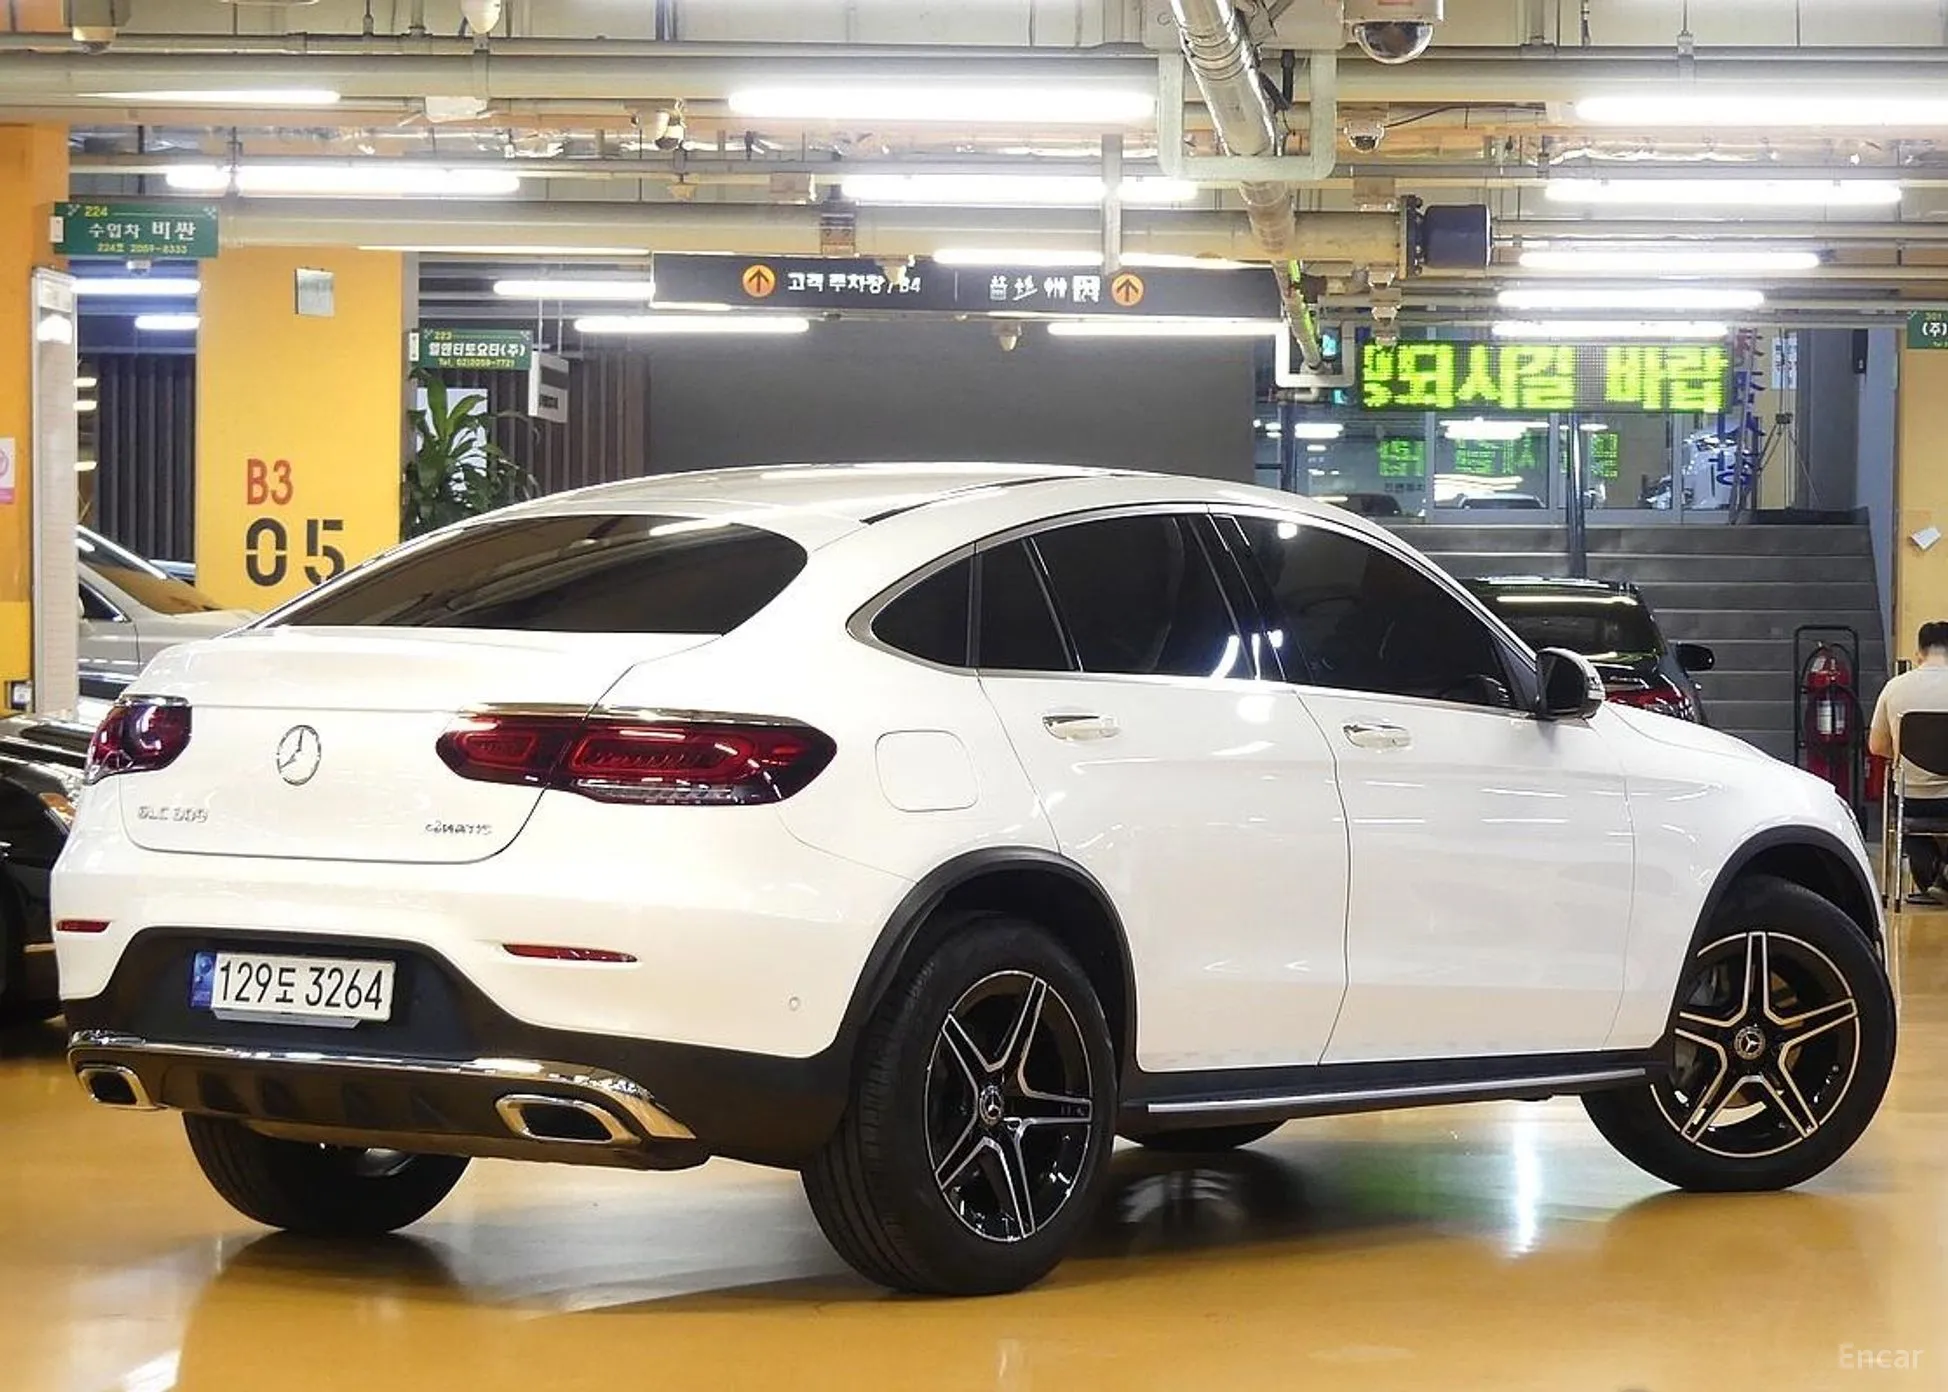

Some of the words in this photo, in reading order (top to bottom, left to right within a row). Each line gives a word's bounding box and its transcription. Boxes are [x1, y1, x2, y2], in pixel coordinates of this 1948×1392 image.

[85, 206, 108, 217] 224
[89, 223, 141, 239] 수입차
[152, 221, 196, 241] 비싼
[788, 272, 824, 292] 고객
[246, 458, 293, 505] B3
[220, 960, 296, 1003] 129도
[305, 966, 383, 1011] 3264
